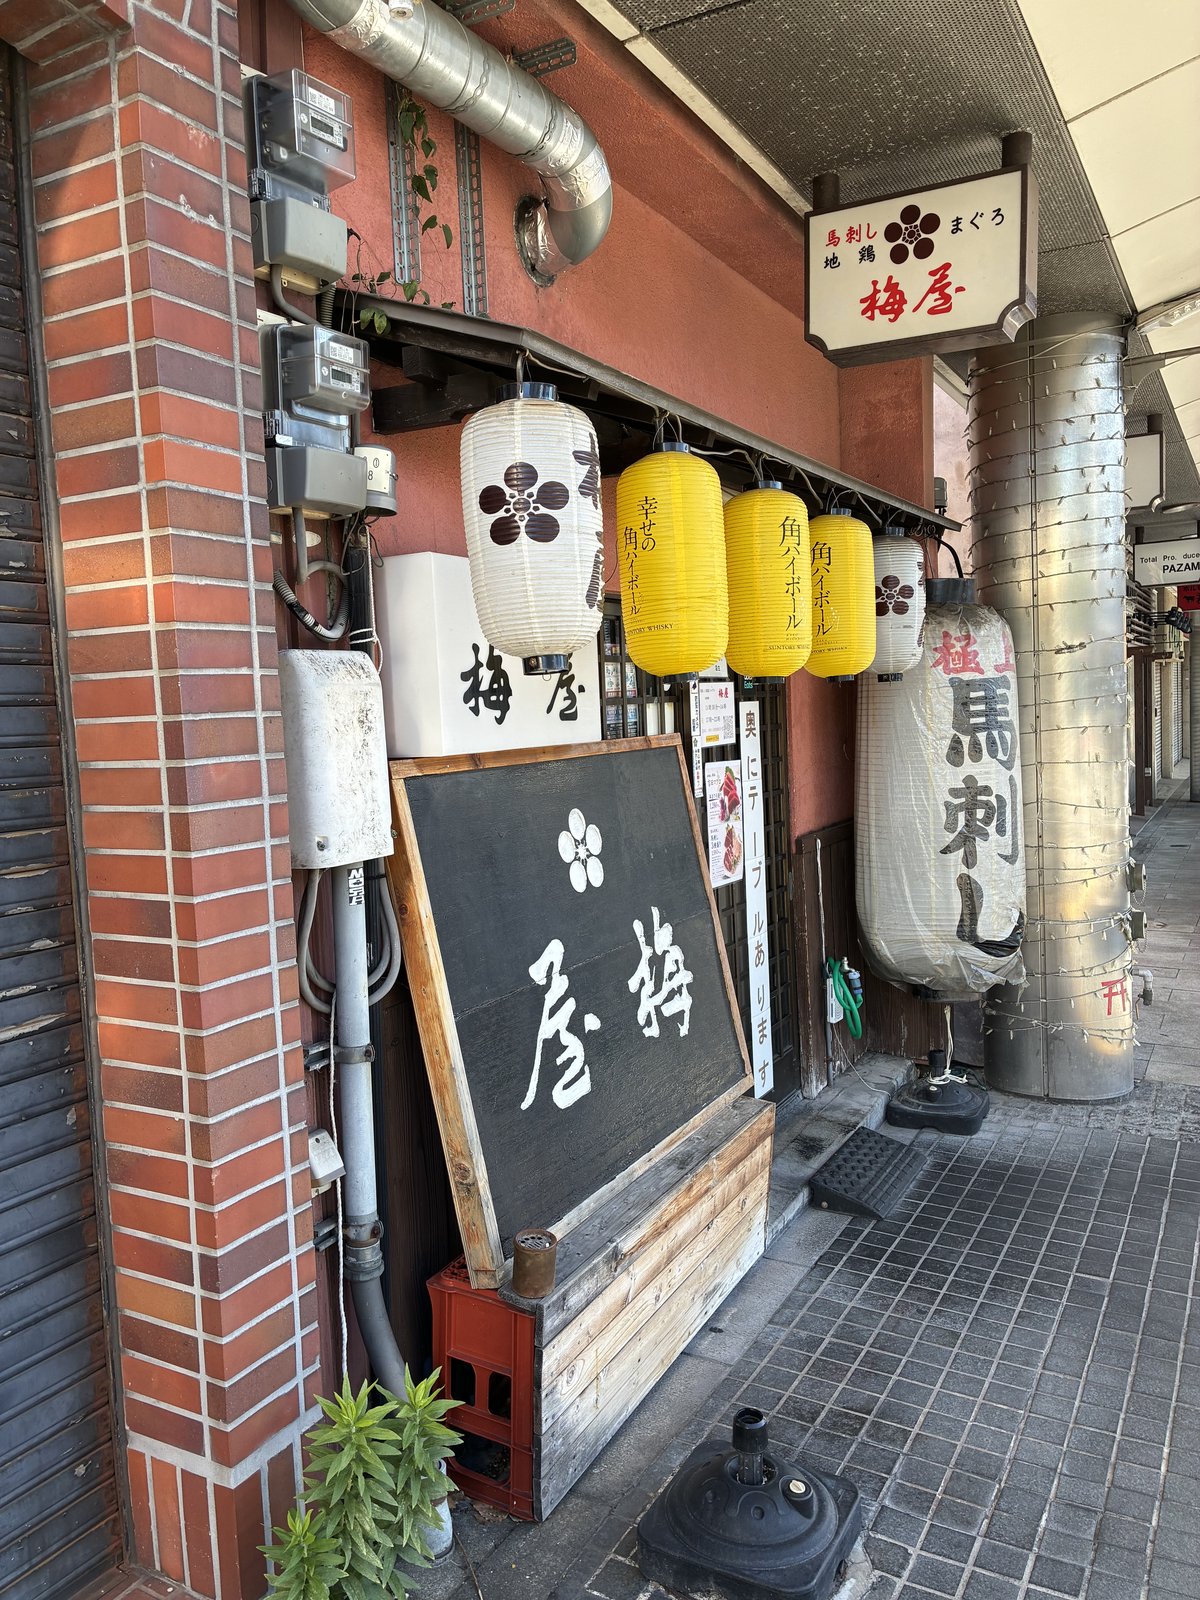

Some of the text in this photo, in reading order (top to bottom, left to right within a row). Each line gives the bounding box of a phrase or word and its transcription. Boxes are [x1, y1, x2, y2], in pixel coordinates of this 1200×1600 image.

[825, 222, 878, 248] 馬刺し
[949, 207, 1006, 236] まぐろ
[823, 244, 877, 270] 地鶏
[858, 261, 967, 324] 梅屋
[637, 495, 659, 552] 幸せの
[623, 526, 642, 616] 角ハイボール
[779, 515, 803, 632] 角ハイボール
[1140, 556, 1158, 564] Total
[1163, 554, 1177, 562] Pro.
[811, 541, 833, 637] 角ハイボール
[647, 623, 674, 631] WHISKY
[938, 674, 1023, 957] 馬刺し
